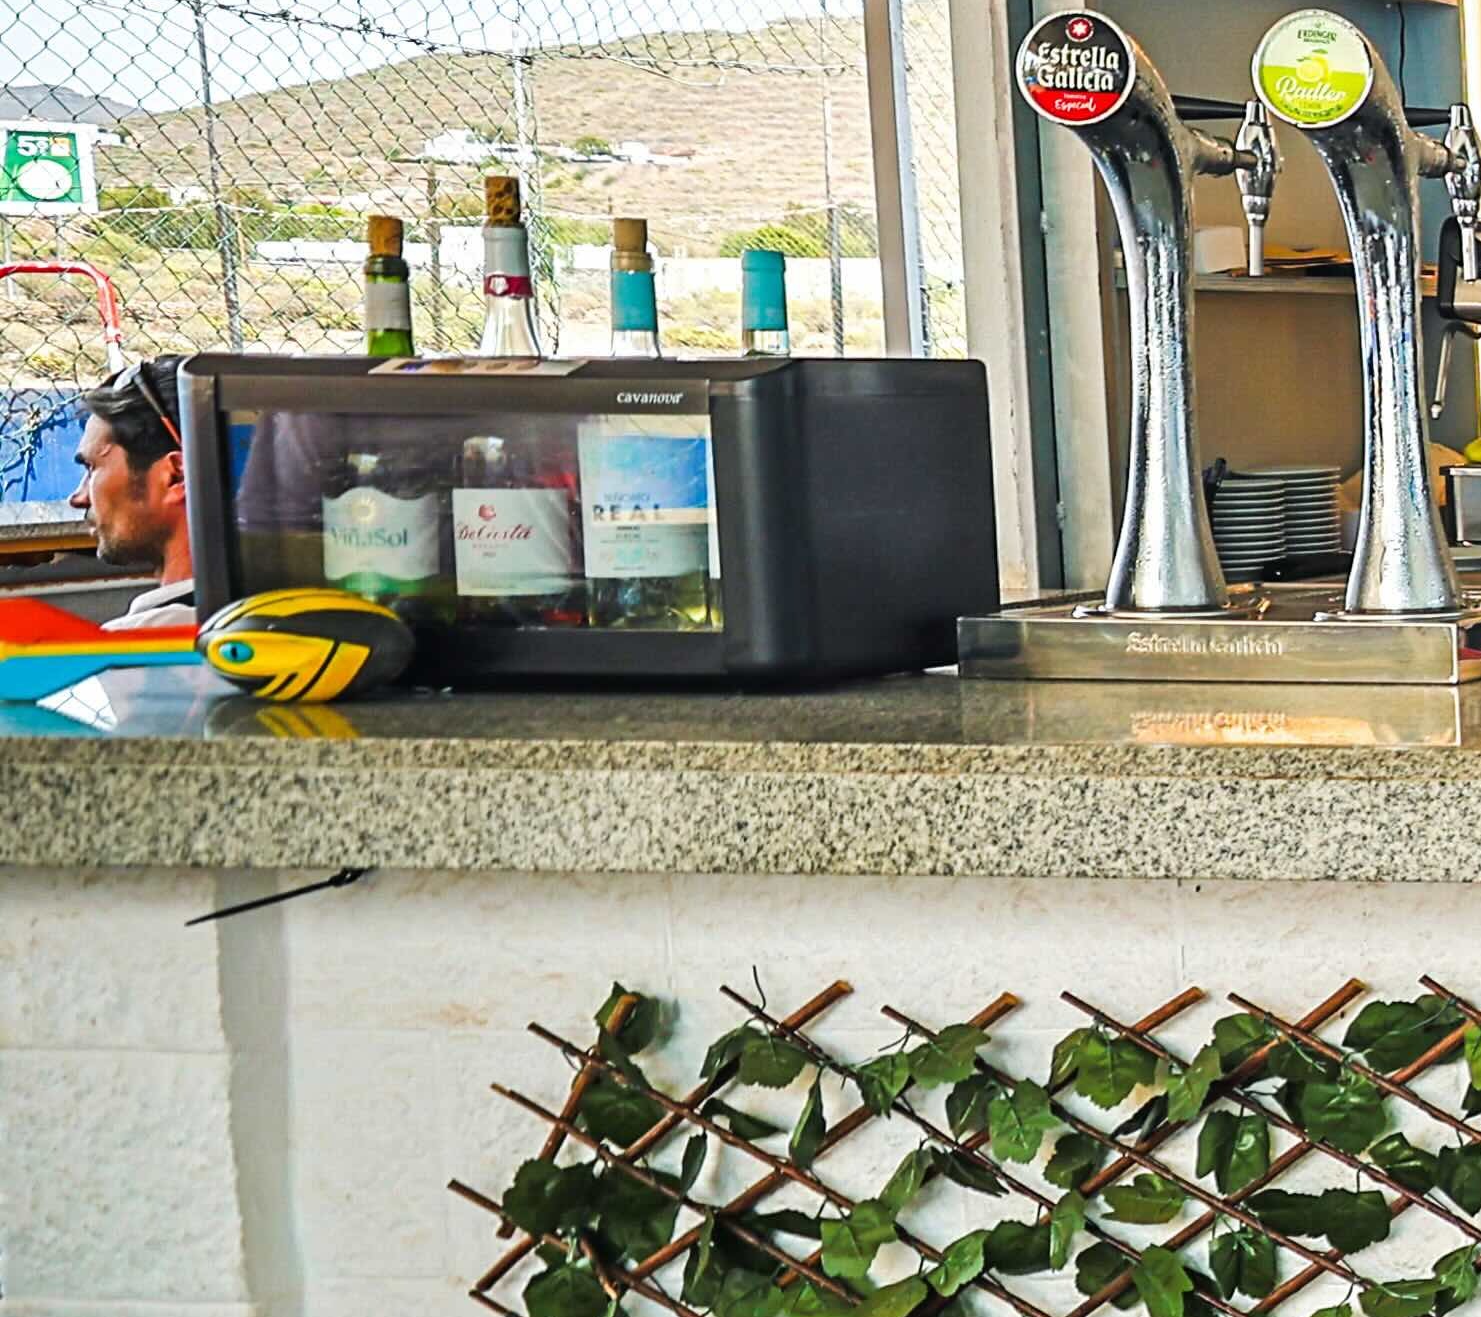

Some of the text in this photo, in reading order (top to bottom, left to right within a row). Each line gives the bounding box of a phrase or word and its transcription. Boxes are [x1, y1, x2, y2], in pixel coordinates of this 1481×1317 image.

[1037, 41, 1120, 70] Estrella
[1036, 64, 1115, 92] Galicia
[1275, 75, 1347, 104] Radler
[616, 391, 684, 405] cavanova
